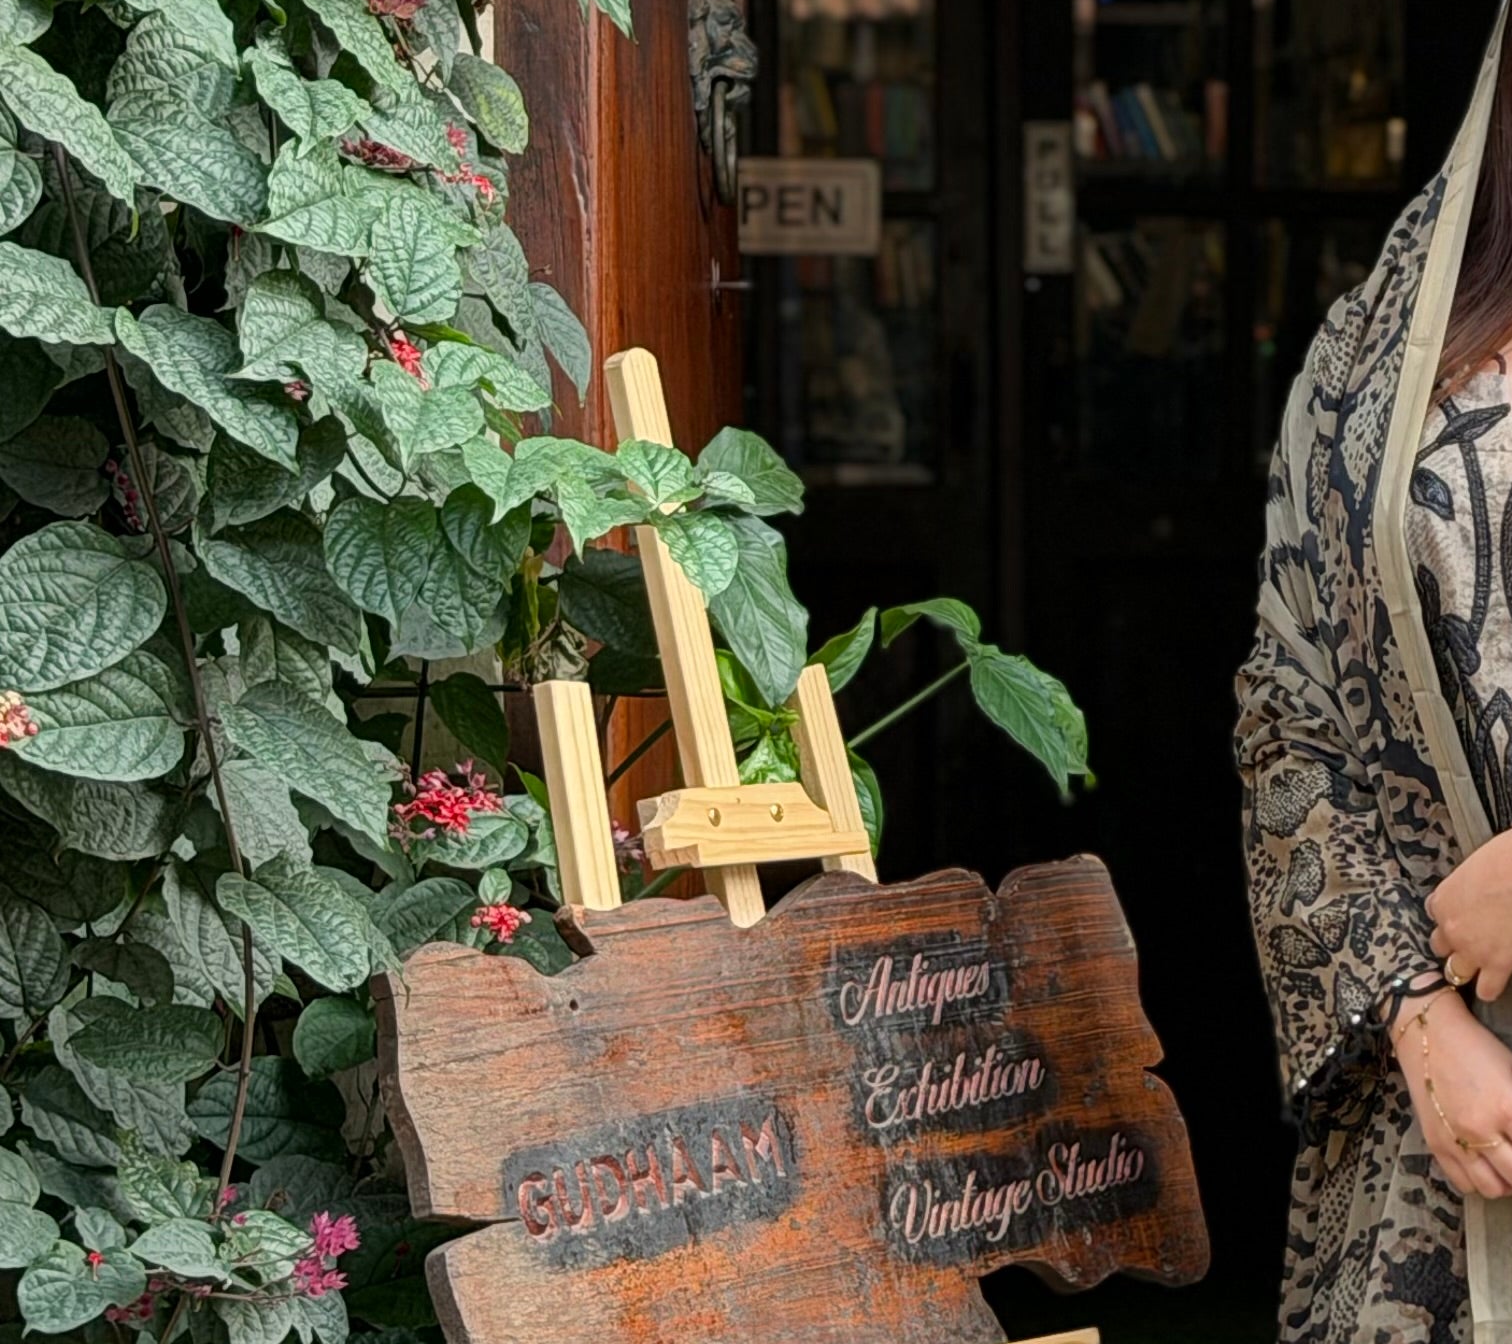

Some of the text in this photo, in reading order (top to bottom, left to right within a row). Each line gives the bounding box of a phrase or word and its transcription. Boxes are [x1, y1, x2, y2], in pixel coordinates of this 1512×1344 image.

[741, 185, 843, 226] PEN
[840, 953, 990, 1025] Antiques
[864, 1044, 1046, 1128] Exhibition
[518, 1114, 786, 1244] GUDHAAM
[889, 1132, 1144, 1244] Vintage Studio
